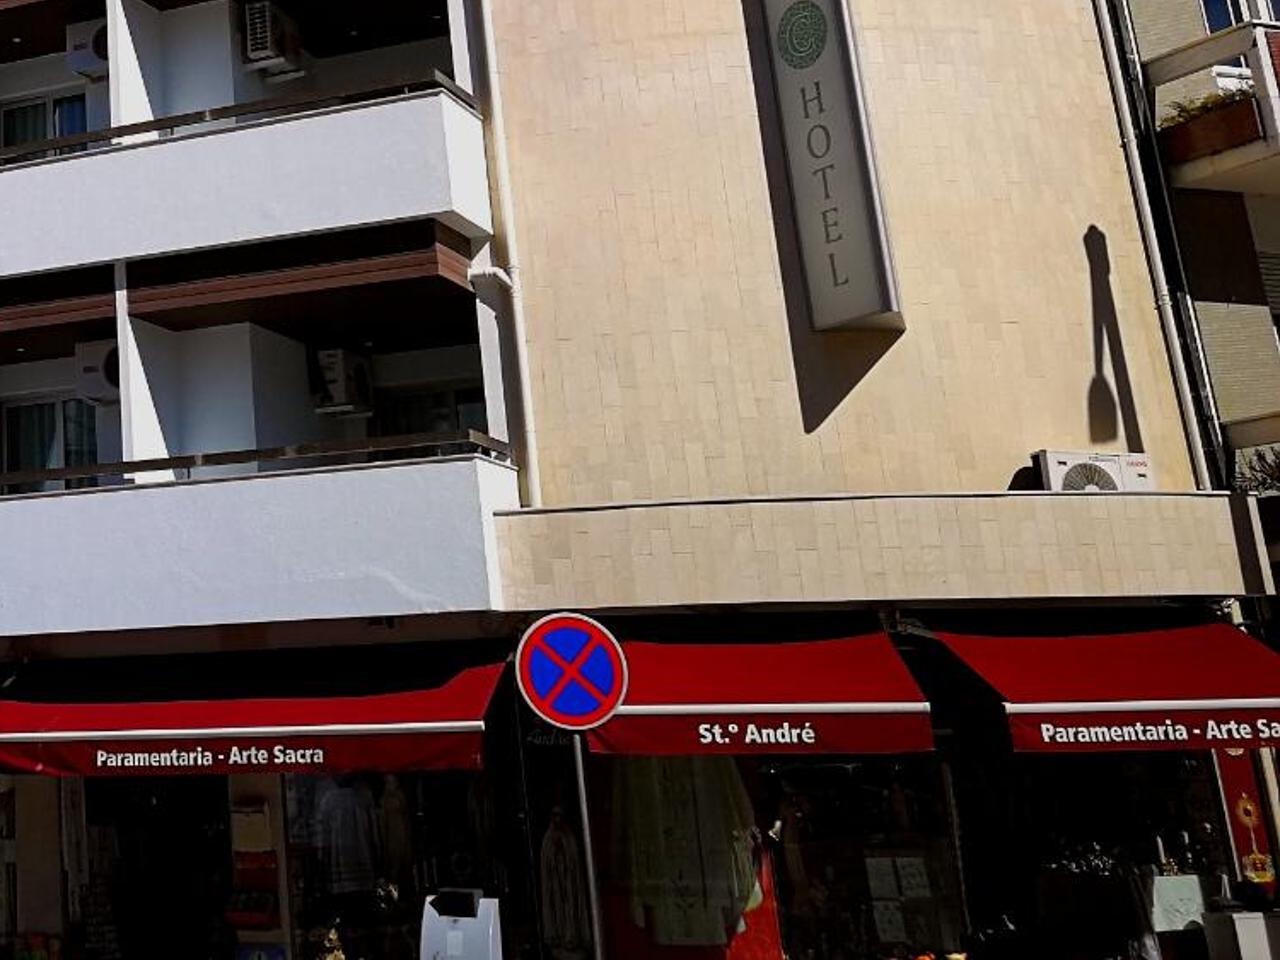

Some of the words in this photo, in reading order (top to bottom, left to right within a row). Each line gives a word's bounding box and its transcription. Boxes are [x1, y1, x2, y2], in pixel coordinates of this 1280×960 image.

[799, 79, 850, 288] HOTEL
[744, 722, 816, 743] André
[1041, 719, 1188, 742] Paramentaria
[1206, 719, 1253, 740] Arte
[96, 746, 213, 767] Paramentaria
[228, 746, 269, 766] Arte
[273, 745, 324, 765] Sacra
